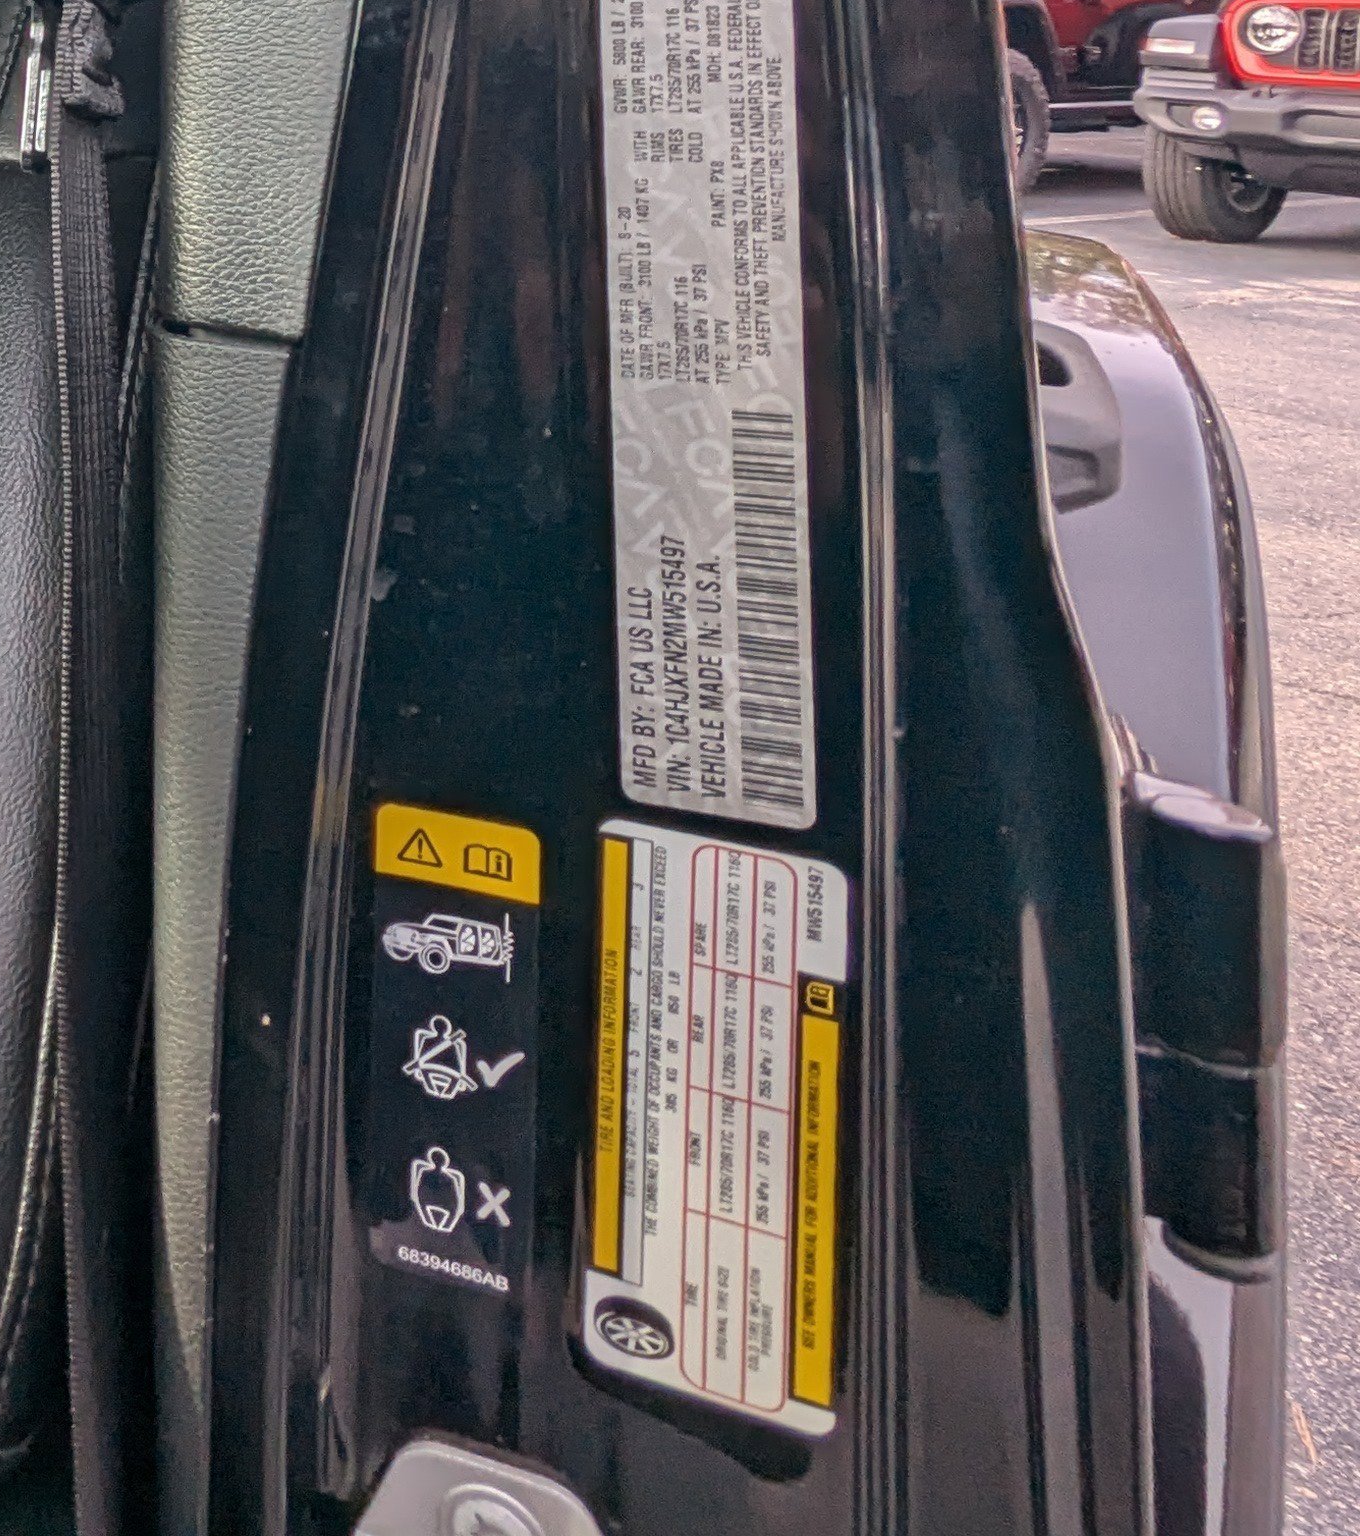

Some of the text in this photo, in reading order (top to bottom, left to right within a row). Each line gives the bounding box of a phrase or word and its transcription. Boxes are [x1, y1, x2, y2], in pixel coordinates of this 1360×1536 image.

[611, 21, 625, 34] LB
[629, 2, 644, 28] 3100
[665, 8, 680, 27] 116
[684, 18, 700, 32] 37
[745, 14, 762, 59] EFFECT
[612, 39, 626, 65] 5800
[686, 49, 700, 70] kPa
[706, 52, 721, 83] MDH:
[728, 56, 744, 93] U.S.A.
[747, 64, 762, 75] IN
[630, 78, 646, 114] GAWR
[686, 73, 701, 94] 255
[686, 99, 702, 114] AT
[747, 80, 765, 153] STANDARDS
[729, 97, 746, 169] APPLICABLE
[766, 101, 783, 146] SHOWN
[633, 131, 648, 161] WITH
[650, 132, 665, 162] RIMS
[668, 128, 684, 163] TIRES
[688, 132, 703, 163] COLD
[634, 178, 649, 194] KG
[731, 175, 747, 196] ALL
[750, 157, 767, 234] PREVENTION
[769, 151, 786, 242] MANUFACTURE
[635, 198, 650, 224] 1407
[711, 189, 726, 227] PAINT:
[732, 199, 748, 215] TO
[636, 242, 651, 256] LB
[733, 220, 750, 286] CONFORMS
[752, 238, 768, 275] THEFT
[637, 260, 652, 287] 3100
[673, 276, 688, 295] 116
[692, 264, 707, 283] PSI
[693, 287, 707, 301] 37
[753, 280, 770, 306] AND
[619, 298, 634, 324] MFR
[735, 290, 751, 340] VEHICLE
[619, 329, 635, 343] OF
[693, 318, 708, 339] kPa
[755, 312, 771, 357] SAFETY
[620, 348, 635, 379] DATE
[639, 344, 654, 380] GAWR
[694, 343, 709, 363] 255
[737, 344, 752, 371] THIS
[694, 369, 710, 384] AT
[660, 535, 691, 792] VIN: 1C4HJXFN2MW515497
[695, 555, 726, 799] VEHICLE MADE IN: U.S.A.
[626, 587, 656, 788] MFD BY: FCA US LLC
[805, 866, 824, 942] MW515497
[599, 947, 618, 1153] TIRE AND LOADING INFORMATION
[644, 845, 667, 1235] THE COMBINED WEIGHT OF OCCUPANTS AND CARGO SHOULD NEVER EXCEED
[397, 1245, 510, 1292] 68394686AB
